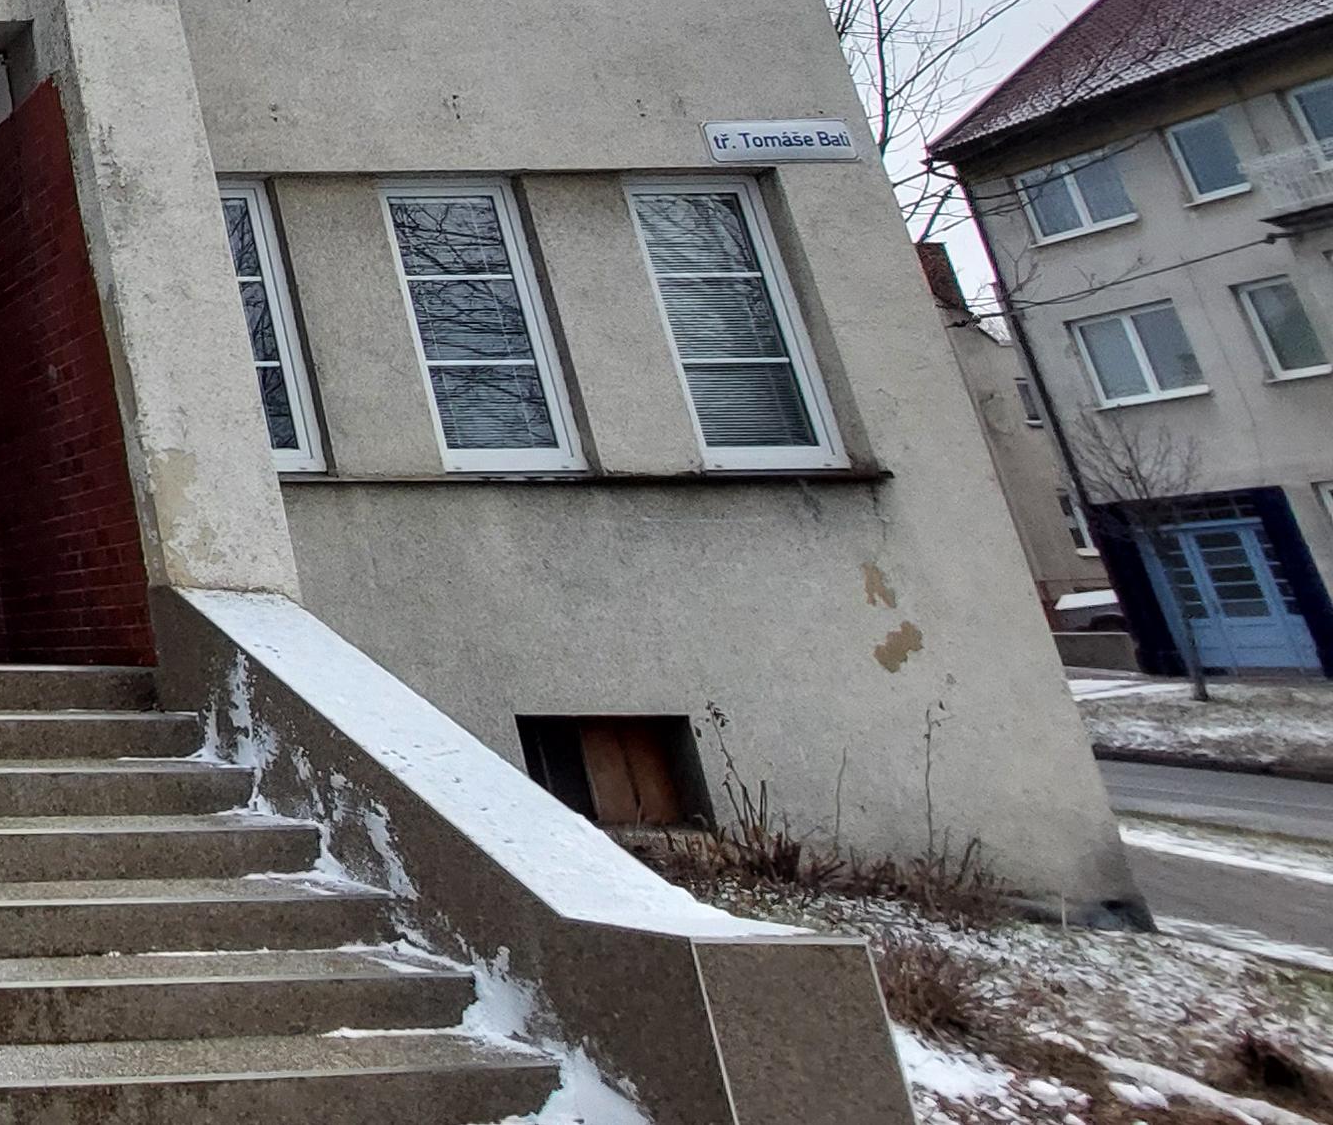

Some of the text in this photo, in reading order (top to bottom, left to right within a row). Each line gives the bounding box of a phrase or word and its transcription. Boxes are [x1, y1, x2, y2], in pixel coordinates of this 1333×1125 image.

[713, 131, 852, 149] tř. Tomáše Bati
